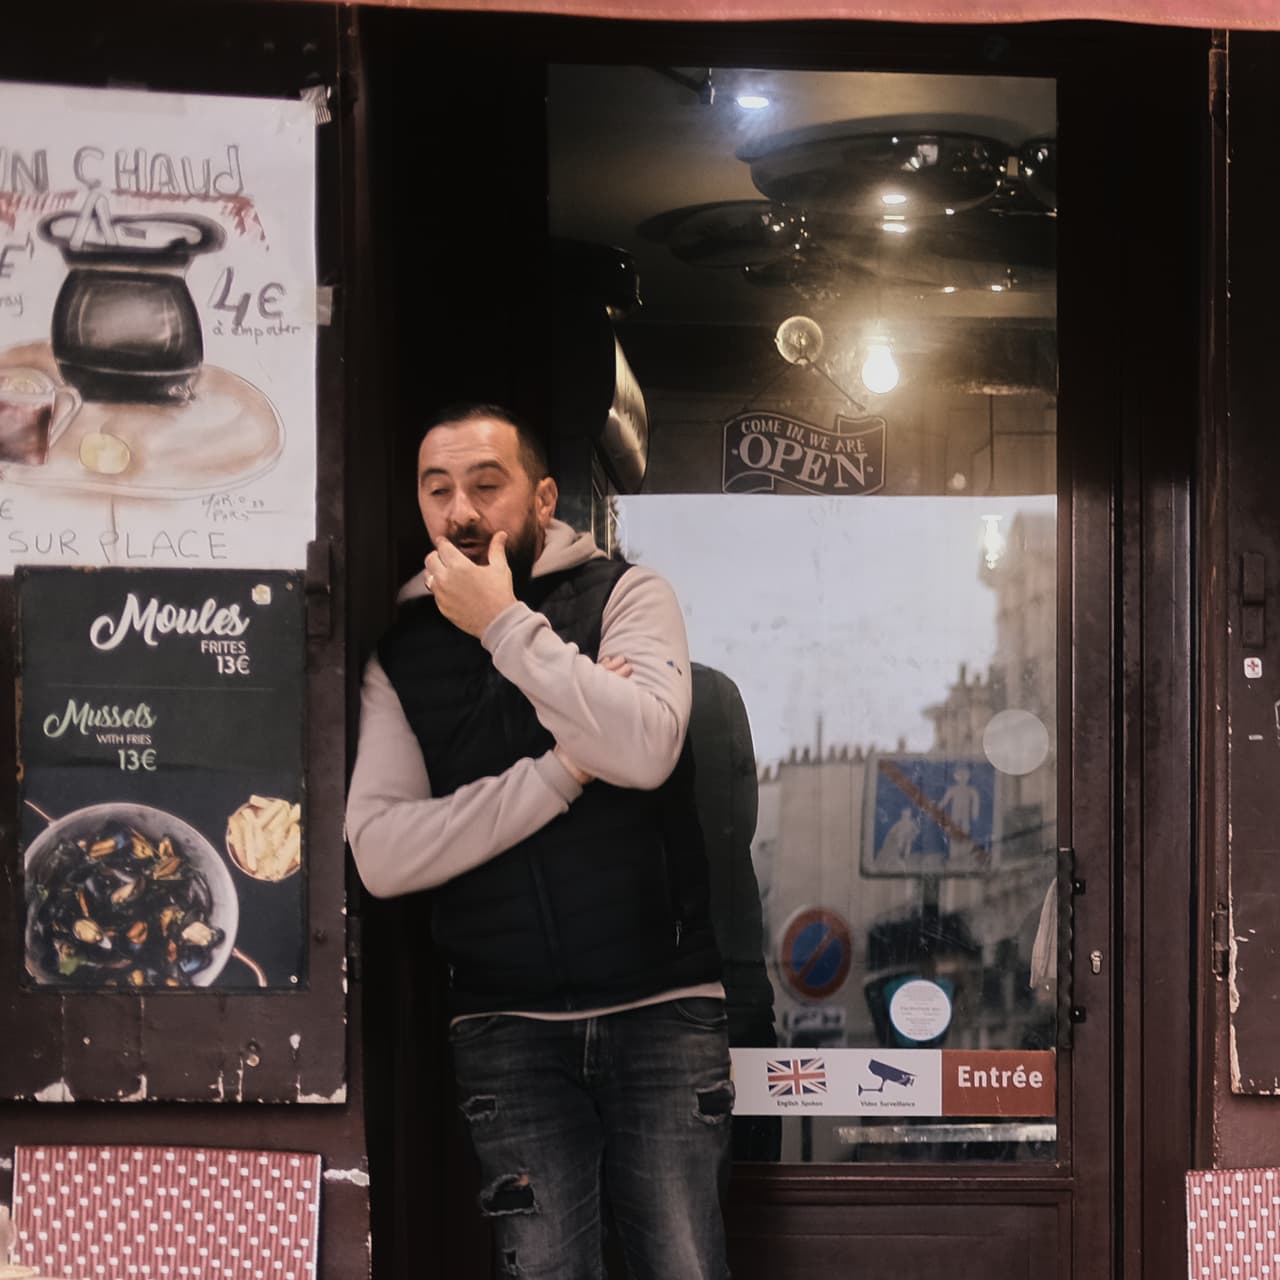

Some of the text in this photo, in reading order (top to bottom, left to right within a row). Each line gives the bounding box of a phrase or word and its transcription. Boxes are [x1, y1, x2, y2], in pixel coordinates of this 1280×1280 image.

[741, 419, 782, 434] COME
[809, 432, 831, 448] WE
[835, 439, 865, 454] ARE
[739, 433, 868, 488] OPEN
[8, 529, 227, 563] SUR PLACE
[90, 593, 250, 650] Moules
[201, 640, 246, 654] FRITES
[217, 655, 250, 675] 13€
[43, 699, 157, 738] Mussels
[96, 734, 152, 745] WITH FRIES
[118, 749, 157, 771] 13€
[958, 1064, 1043, 1088] Entrée
